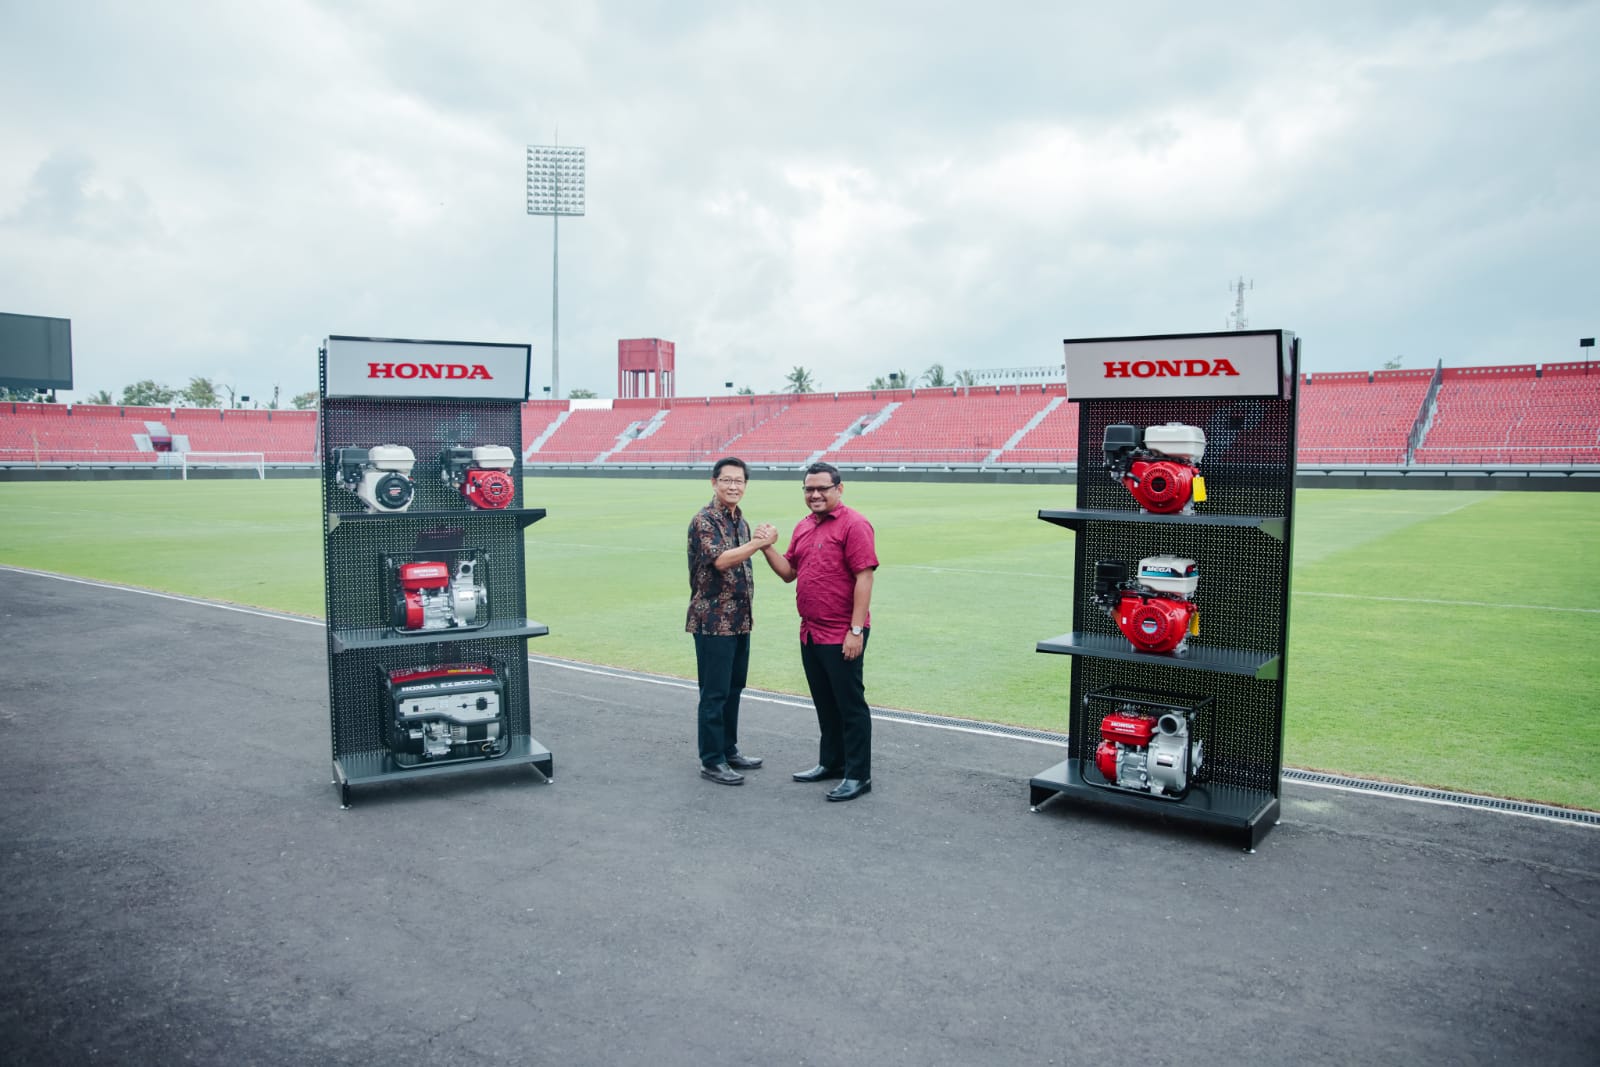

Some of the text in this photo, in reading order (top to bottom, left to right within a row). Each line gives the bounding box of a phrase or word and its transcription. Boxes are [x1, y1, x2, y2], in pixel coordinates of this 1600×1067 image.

[367, 362, 493, 380] HONDA
[1103, 358, 1240, 378] HONDA
[401, 683, 437, 692] HONDA
